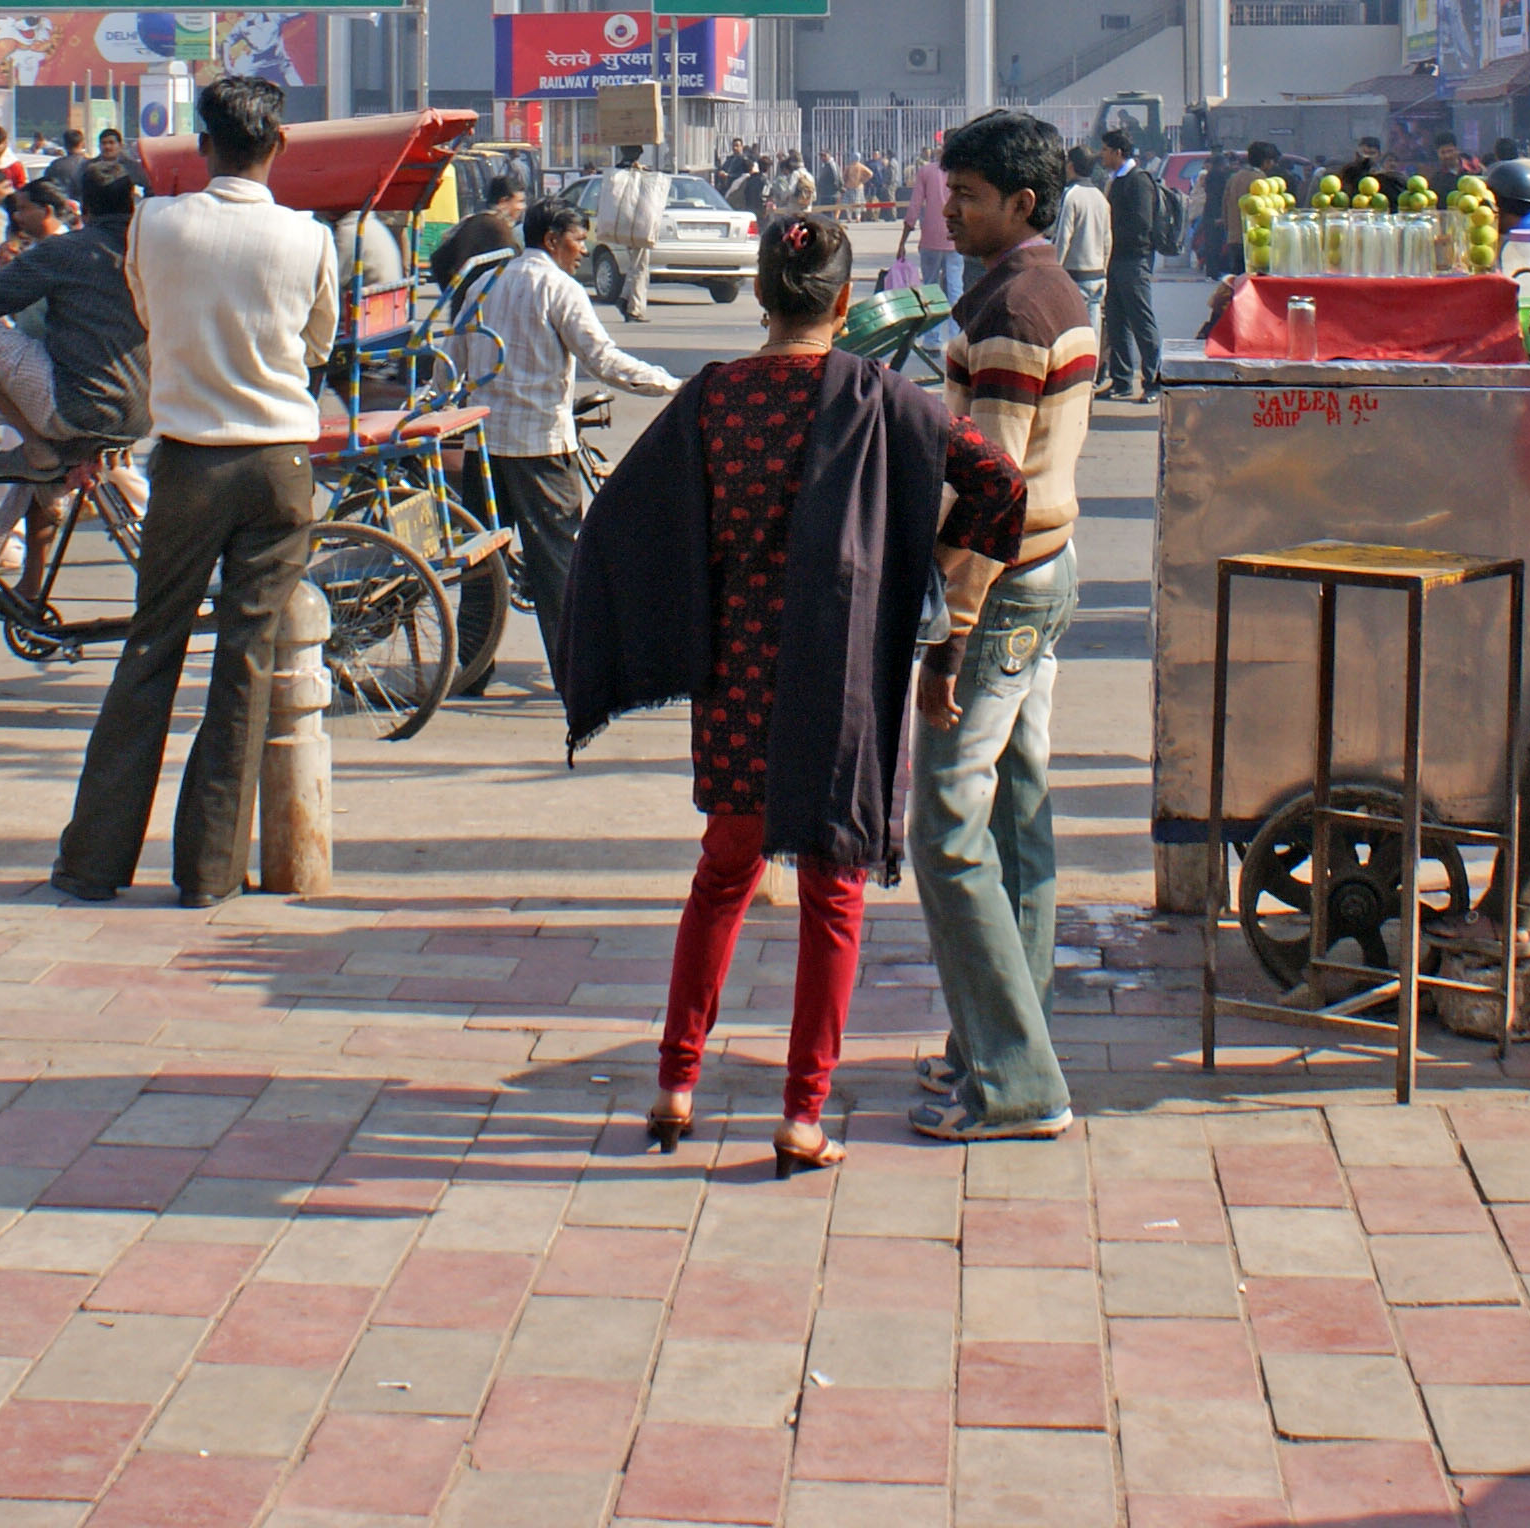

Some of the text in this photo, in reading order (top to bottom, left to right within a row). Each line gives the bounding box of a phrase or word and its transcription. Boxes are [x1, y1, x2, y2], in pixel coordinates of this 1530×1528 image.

[546, 50, 591, 67] रेलवे
[599, 52, 653, 71] सुरक्षा
[539, 75, 588, 90] RAILWAY
